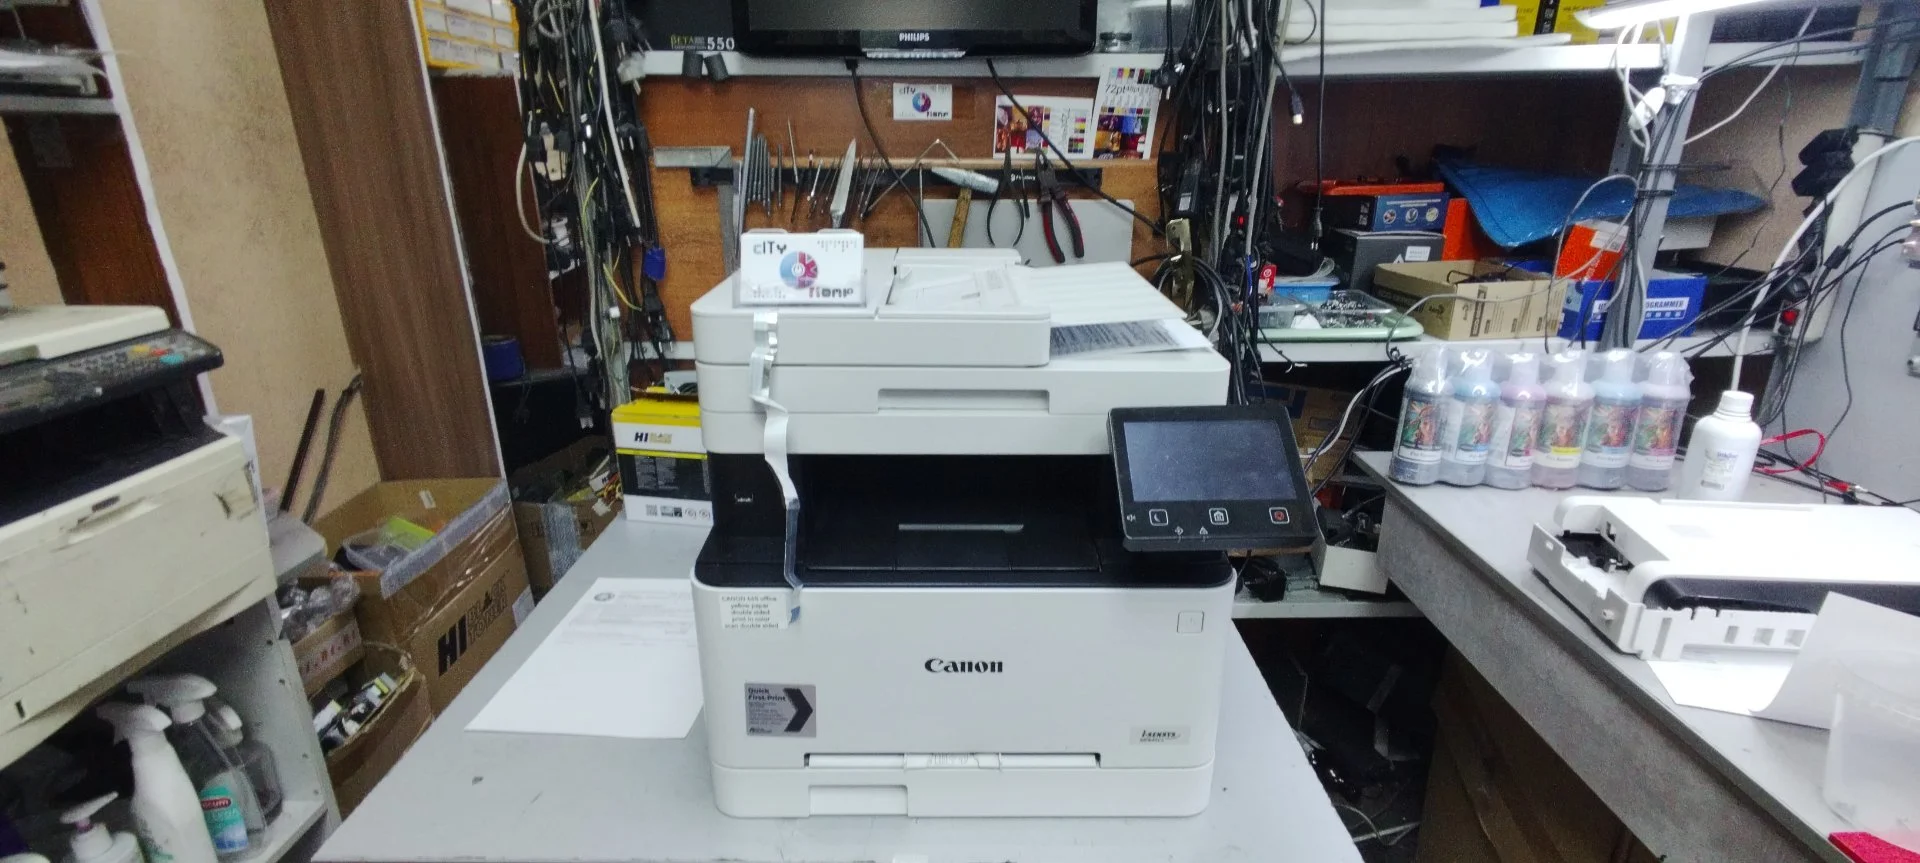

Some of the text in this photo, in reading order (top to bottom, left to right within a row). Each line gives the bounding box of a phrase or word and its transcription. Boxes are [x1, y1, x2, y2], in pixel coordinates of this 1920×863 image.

[707, 36, 735, 50] 550
[899, 32, 930, 42] PHILIPS
[634, 432, 649, 443] HI
[437, 614, 467, 676] HI
[924, 657, 1004, 673] Canon
